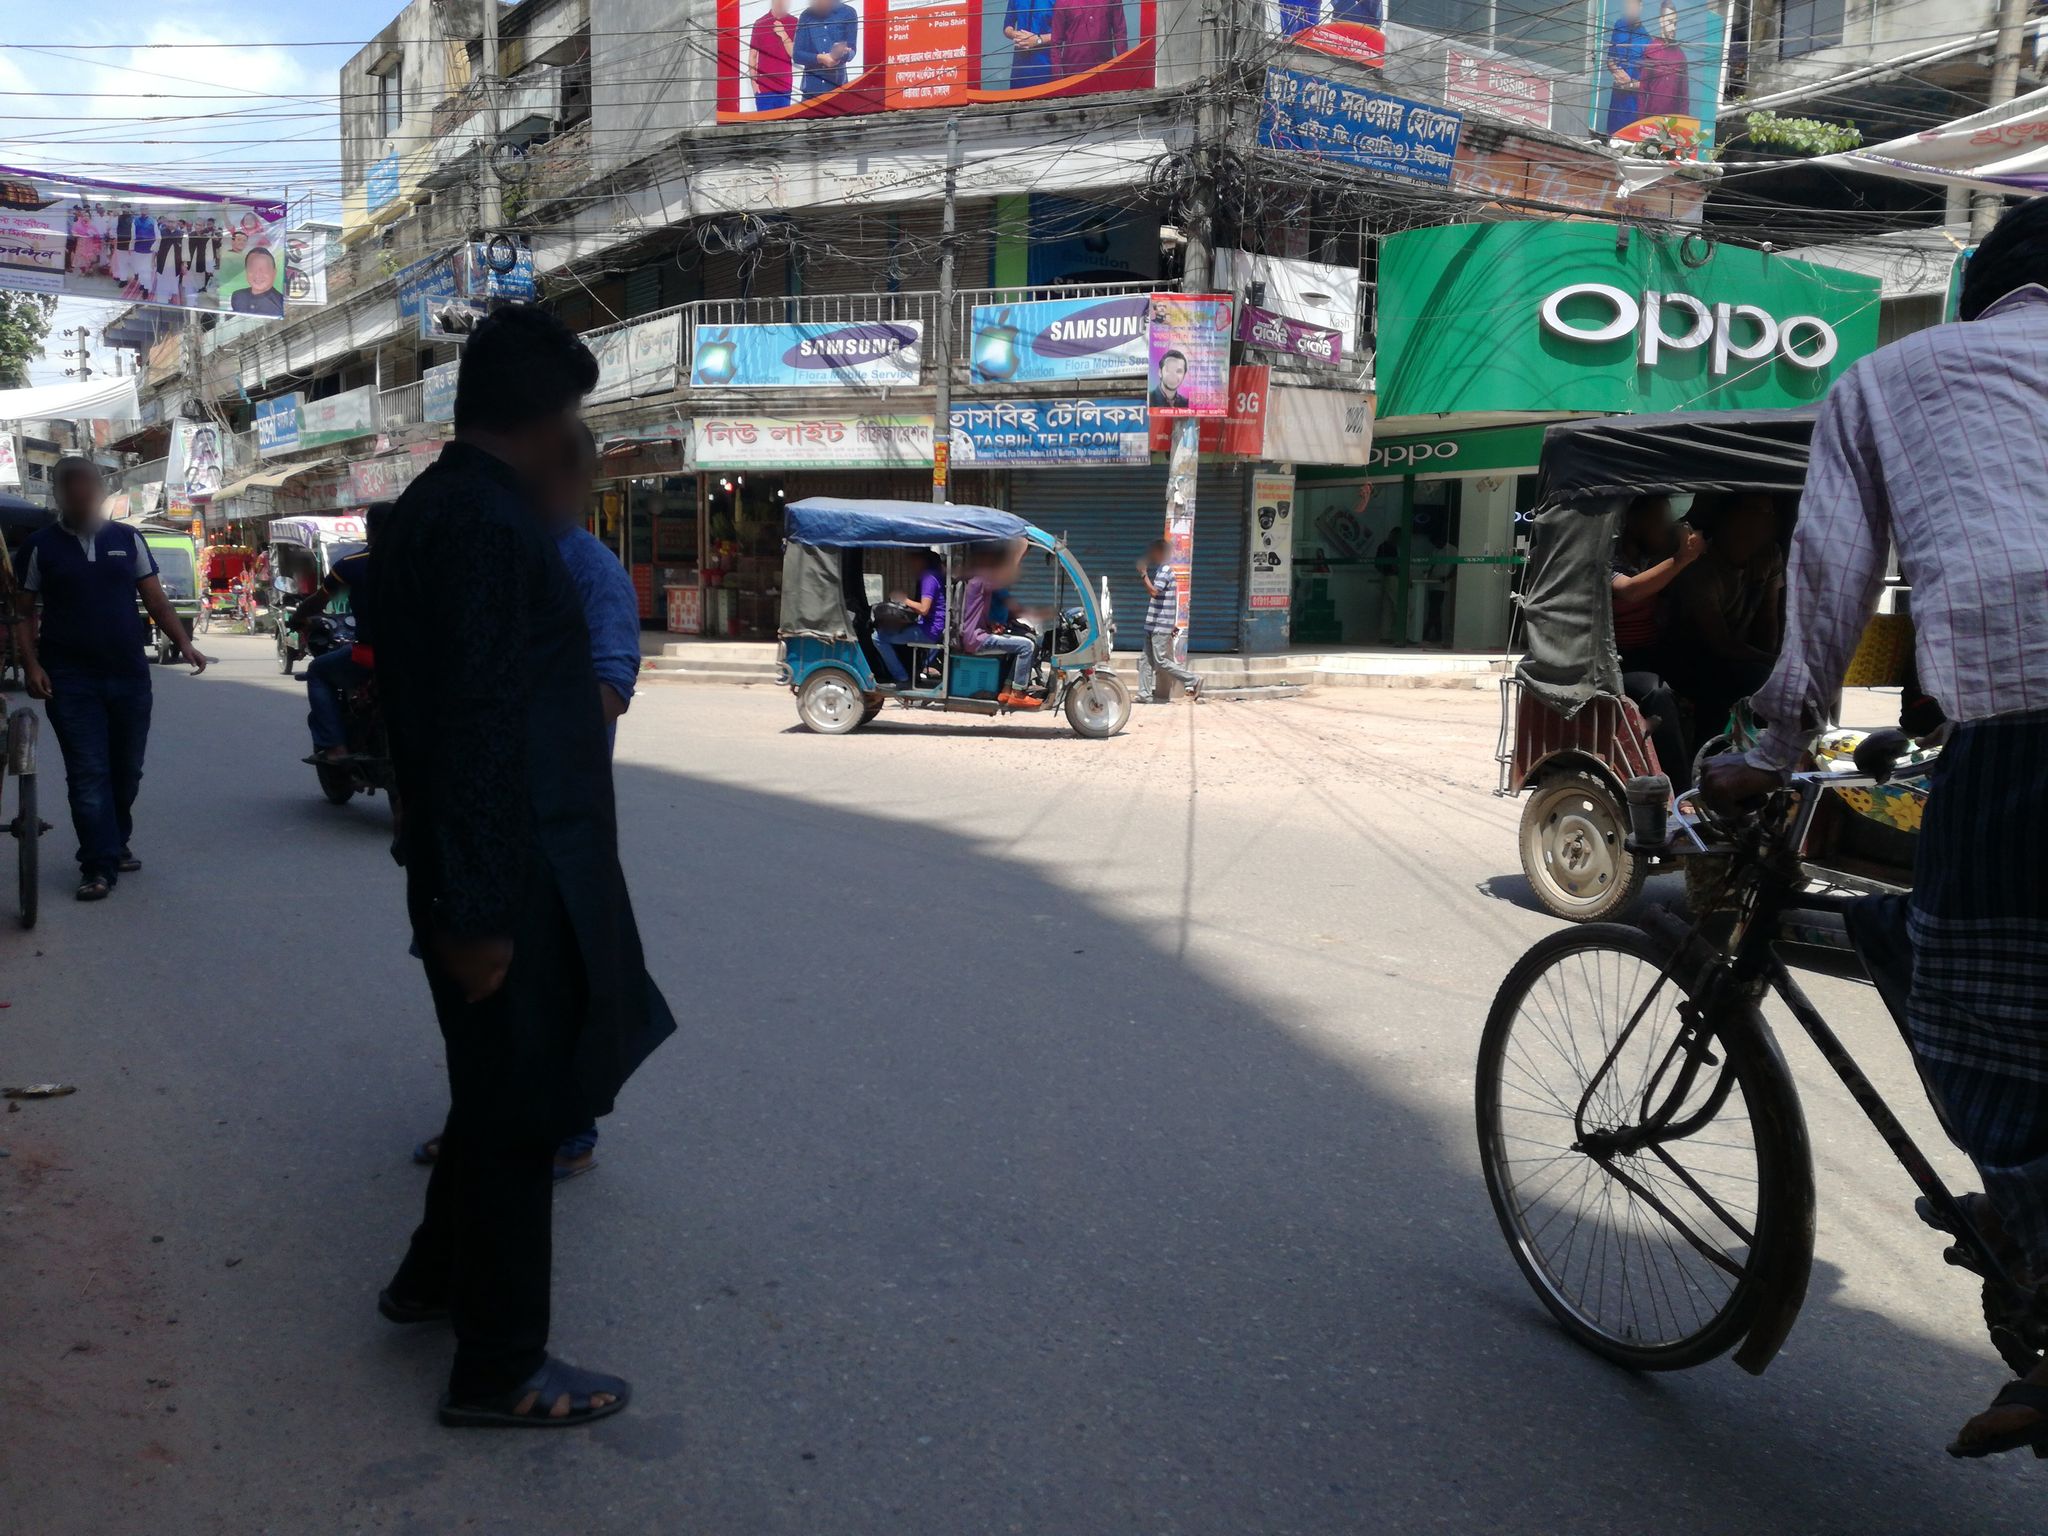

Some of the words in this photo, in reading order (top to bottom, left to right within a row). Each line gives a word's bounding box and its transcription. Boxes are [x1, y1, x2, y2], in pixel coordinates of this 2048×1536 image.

[893, 24, 910, 32] Shirt
[934, 20, 949, 28] Polo
[950, 18, 967, 26] Shirt
[893, 33, 909, 41] Pant
[1488, 73, 1537, 100] POSSIBLE
[1302, 80, 1337, 115] মোঃ
[1340, 89, 1405, 132] সরওয়ার
[1407, 106, 1461, 144] হোসেন
[1539, 282, 1839, 376] oppo
[801, 337, 900, 357] SAMSUNG
[1065, 360, 1090, 371] Flora
[1093, 357, 1126, 370] Mobile
[798, 370, 827, 380] Flora
[830, 369, 868, 380] Mobile
[871, 369, 913, 379] Service
[1236, 392, 1260, 413] 3G
[1046, 400, 1148, 428] টেলিকম
[704, 420, 760, 447] নিউ
[767, 420, 848, 447] লাইট
[974, 433, 1033, 449] TASBIH
[1037, 432, 1119, 448] TELECOM
